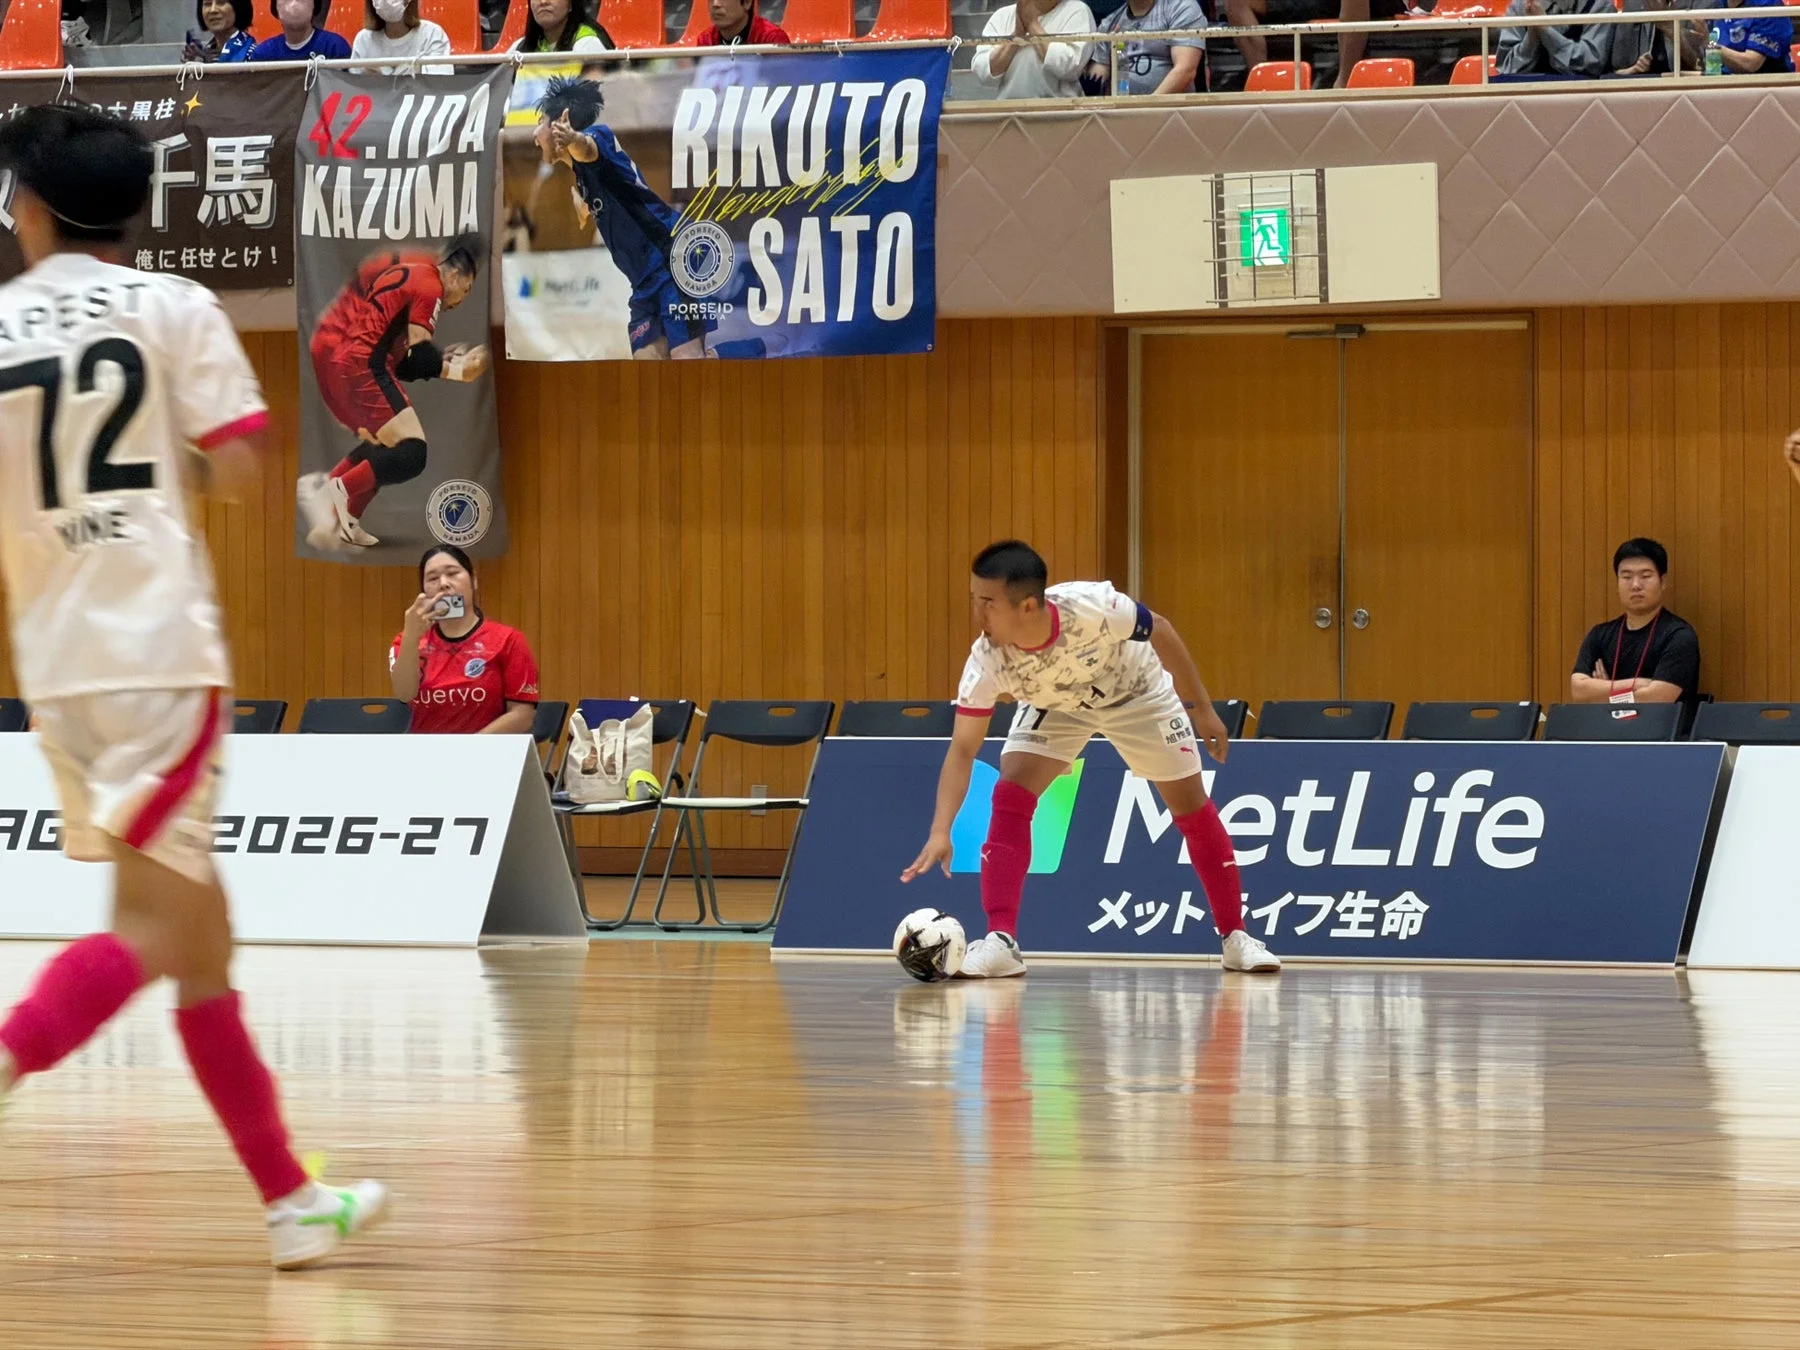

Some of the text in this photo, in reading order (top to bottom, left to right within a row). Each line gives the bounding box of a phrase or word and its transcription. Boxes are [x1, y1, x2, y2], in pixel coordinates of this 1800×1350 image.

[671, 78, 927, 189] RIKUTO
[301, 161, 479, 240] KAZUMA
[684, 226, 721, 240] PORSEID
[684, 280, 718, 292] HAMADA
[747, 211, 914, 327] SATO
[668, 303, 734, 315] PORSEID
[0, 336, 158, 511] 72
[412, 687, 486, 704] uervo
[209, 815, 490, 856] 2026-27
[1103, 769, 1546, 870] MetLife
[1087, 889, 1431, 941] メットイフ生命
